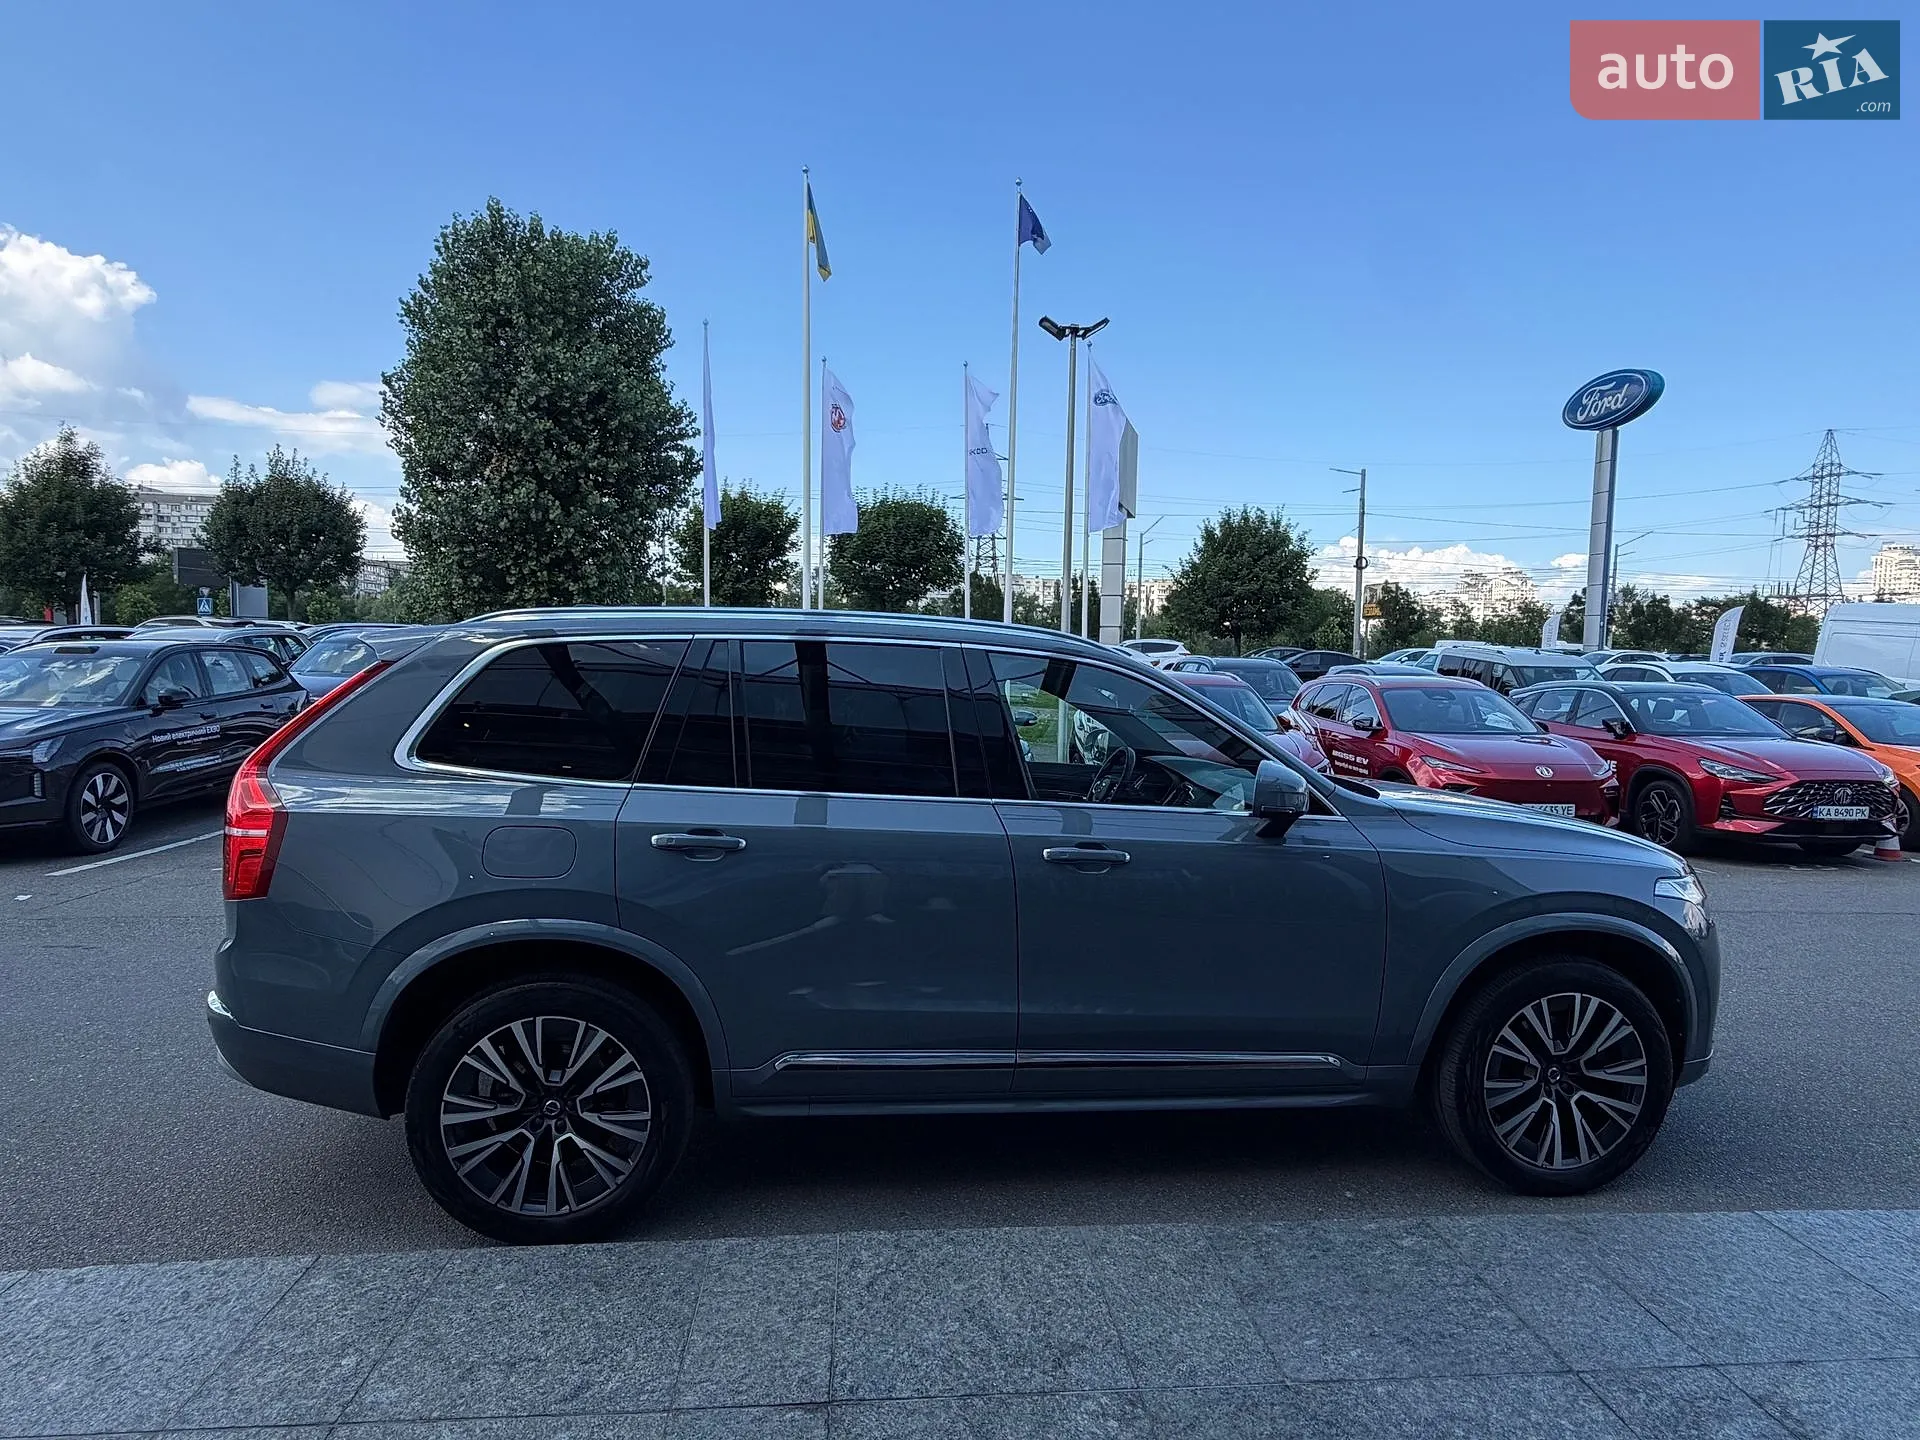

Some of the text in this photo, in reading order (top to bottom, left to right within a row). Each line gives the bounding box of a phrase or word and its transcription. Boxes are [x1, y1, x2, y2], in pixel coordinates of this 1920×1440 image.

[1577, 381, 1629, 421] Ford
[1356, 756, 1369, 765] EV
[1561, 806, 1573, 816] YE
[1819, 808, 1867, 817] KA 8490 PK
